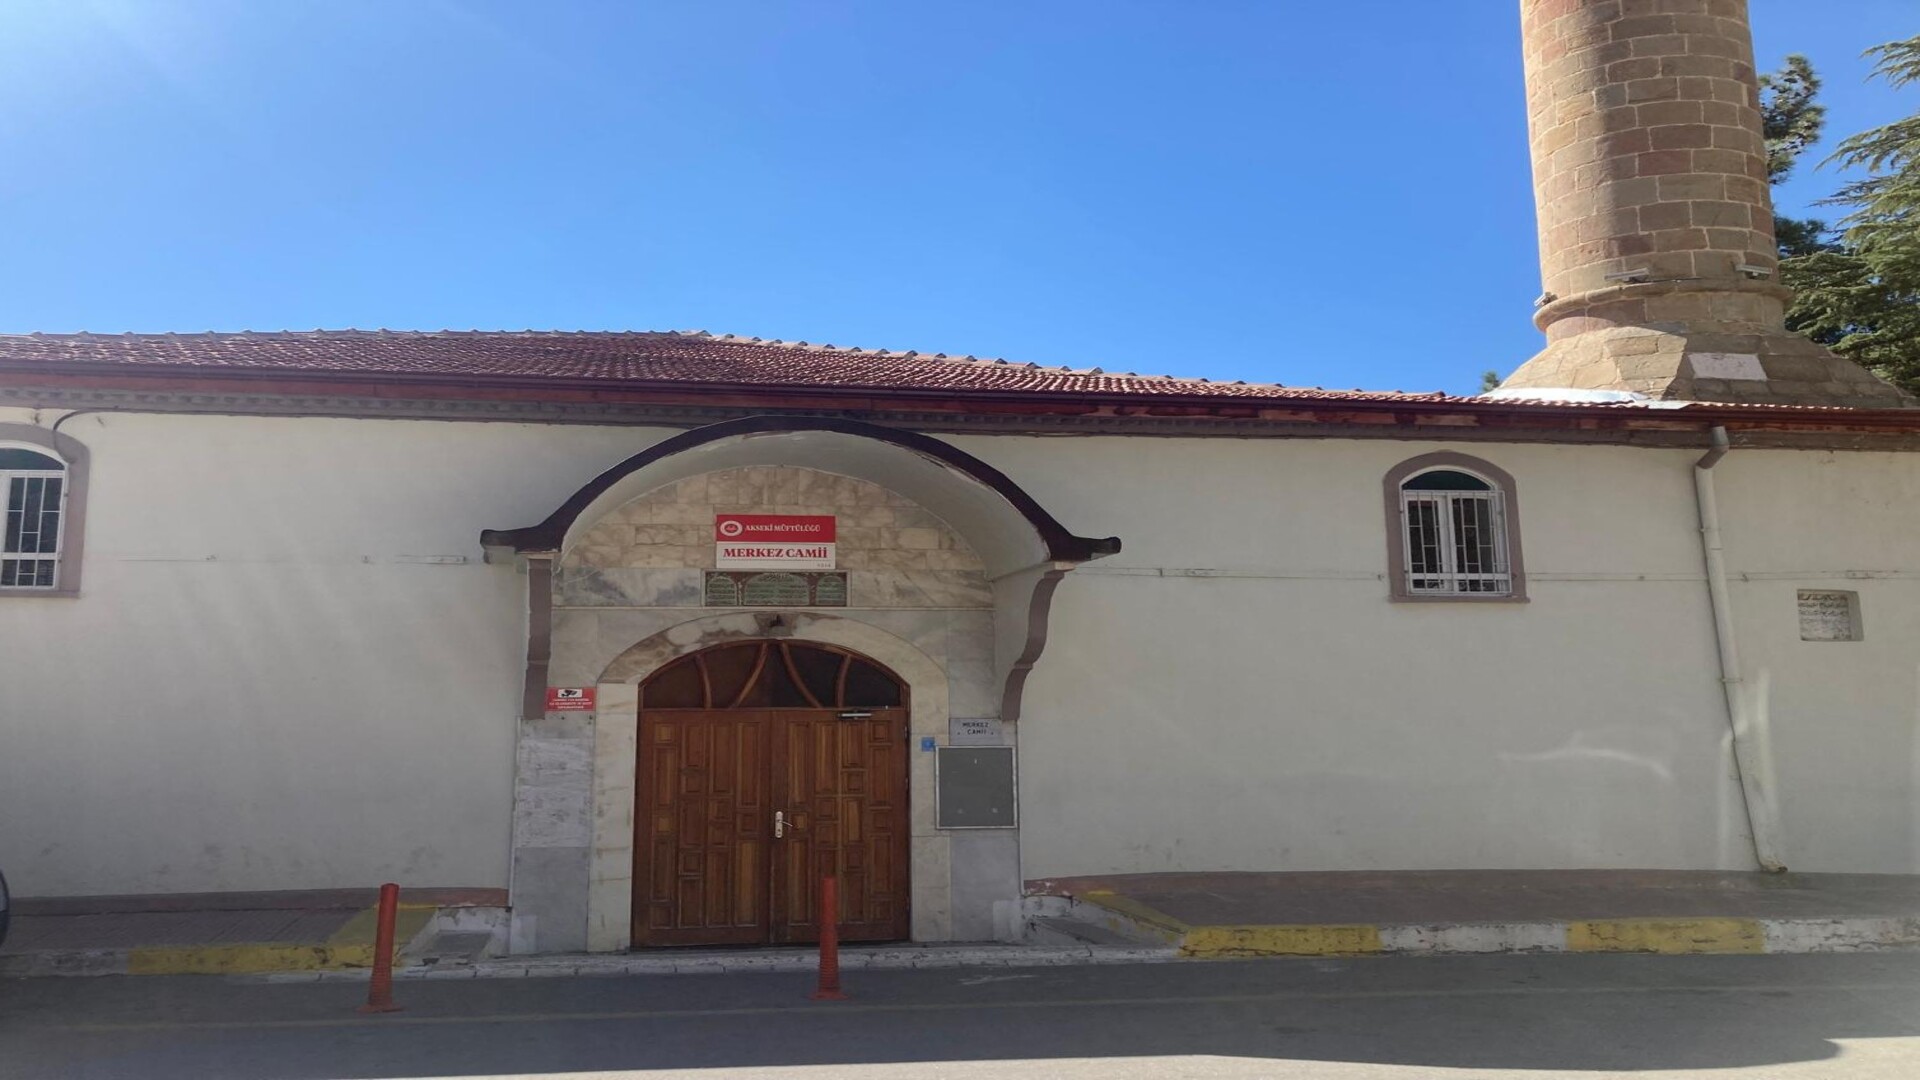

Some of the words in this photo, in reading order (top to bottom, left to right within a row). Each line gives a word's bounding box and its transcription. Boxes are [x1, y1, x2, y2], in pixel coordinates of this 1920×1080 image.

[745, 523, 773, 532] AKSEKİ
[723, 548, 784, 558] MERKEZ
[785, 546, 828, 559] CAMİİ
